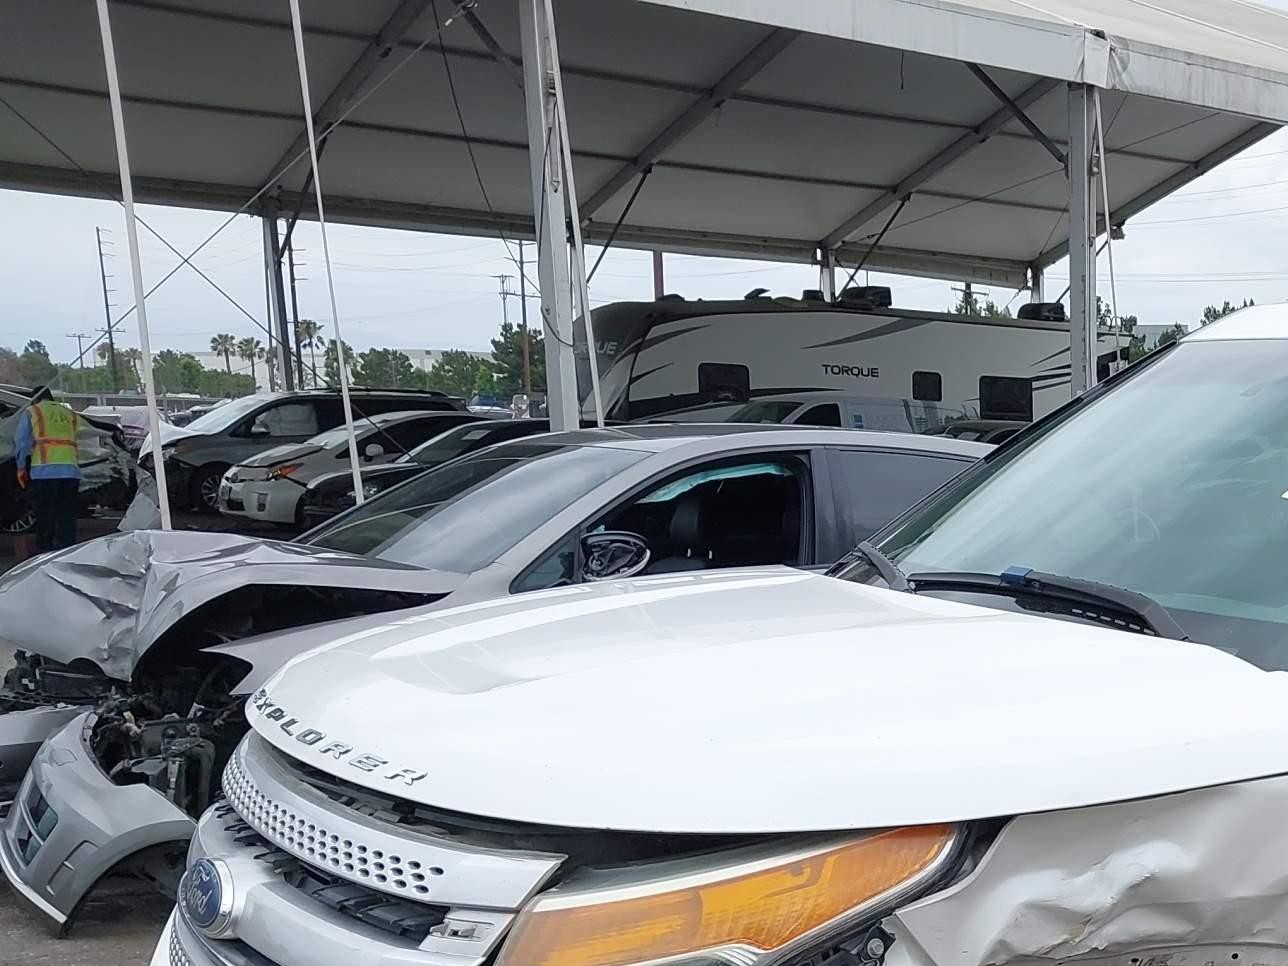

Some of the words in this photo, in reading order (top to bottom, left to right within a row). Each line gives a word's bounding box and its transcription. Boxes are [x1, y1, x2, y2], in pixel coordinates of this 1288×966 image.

[821, 364, 879, 378] TORQUE
[252, 688, 429, 786] EXPLORER
[187, 865, 213, 915] Ford
